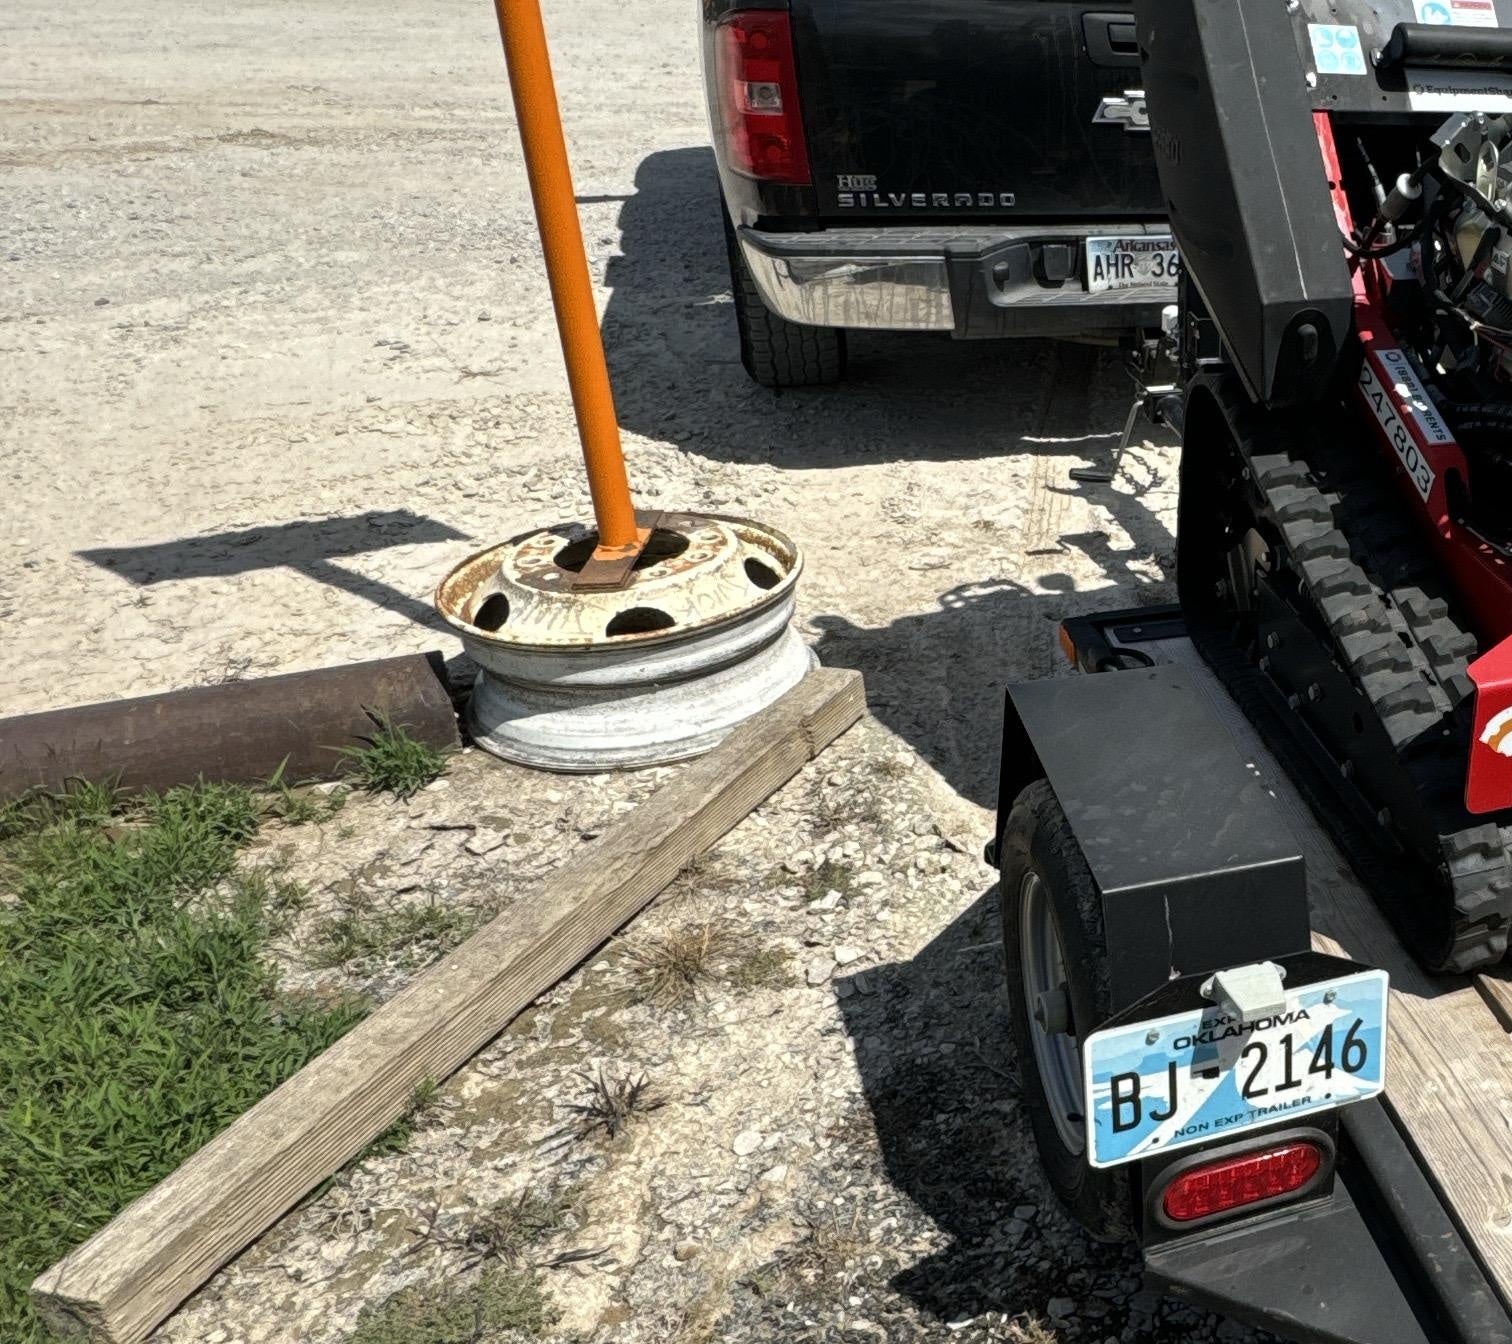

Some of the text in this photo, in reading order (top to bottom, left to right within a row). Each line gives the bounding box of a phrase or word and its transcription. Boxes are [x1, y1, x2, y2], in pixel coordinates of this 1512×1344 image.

[838, 193, 1016, 207] SILVERADO
[1093, 252, 1135, 283] AHR
[1359, 367, 1431, 494] 247803
[1173, 1008, 1311, 1051] OKLAHOMA
[1174, 1095, 1312, 1139] NON EXP TRAILER
